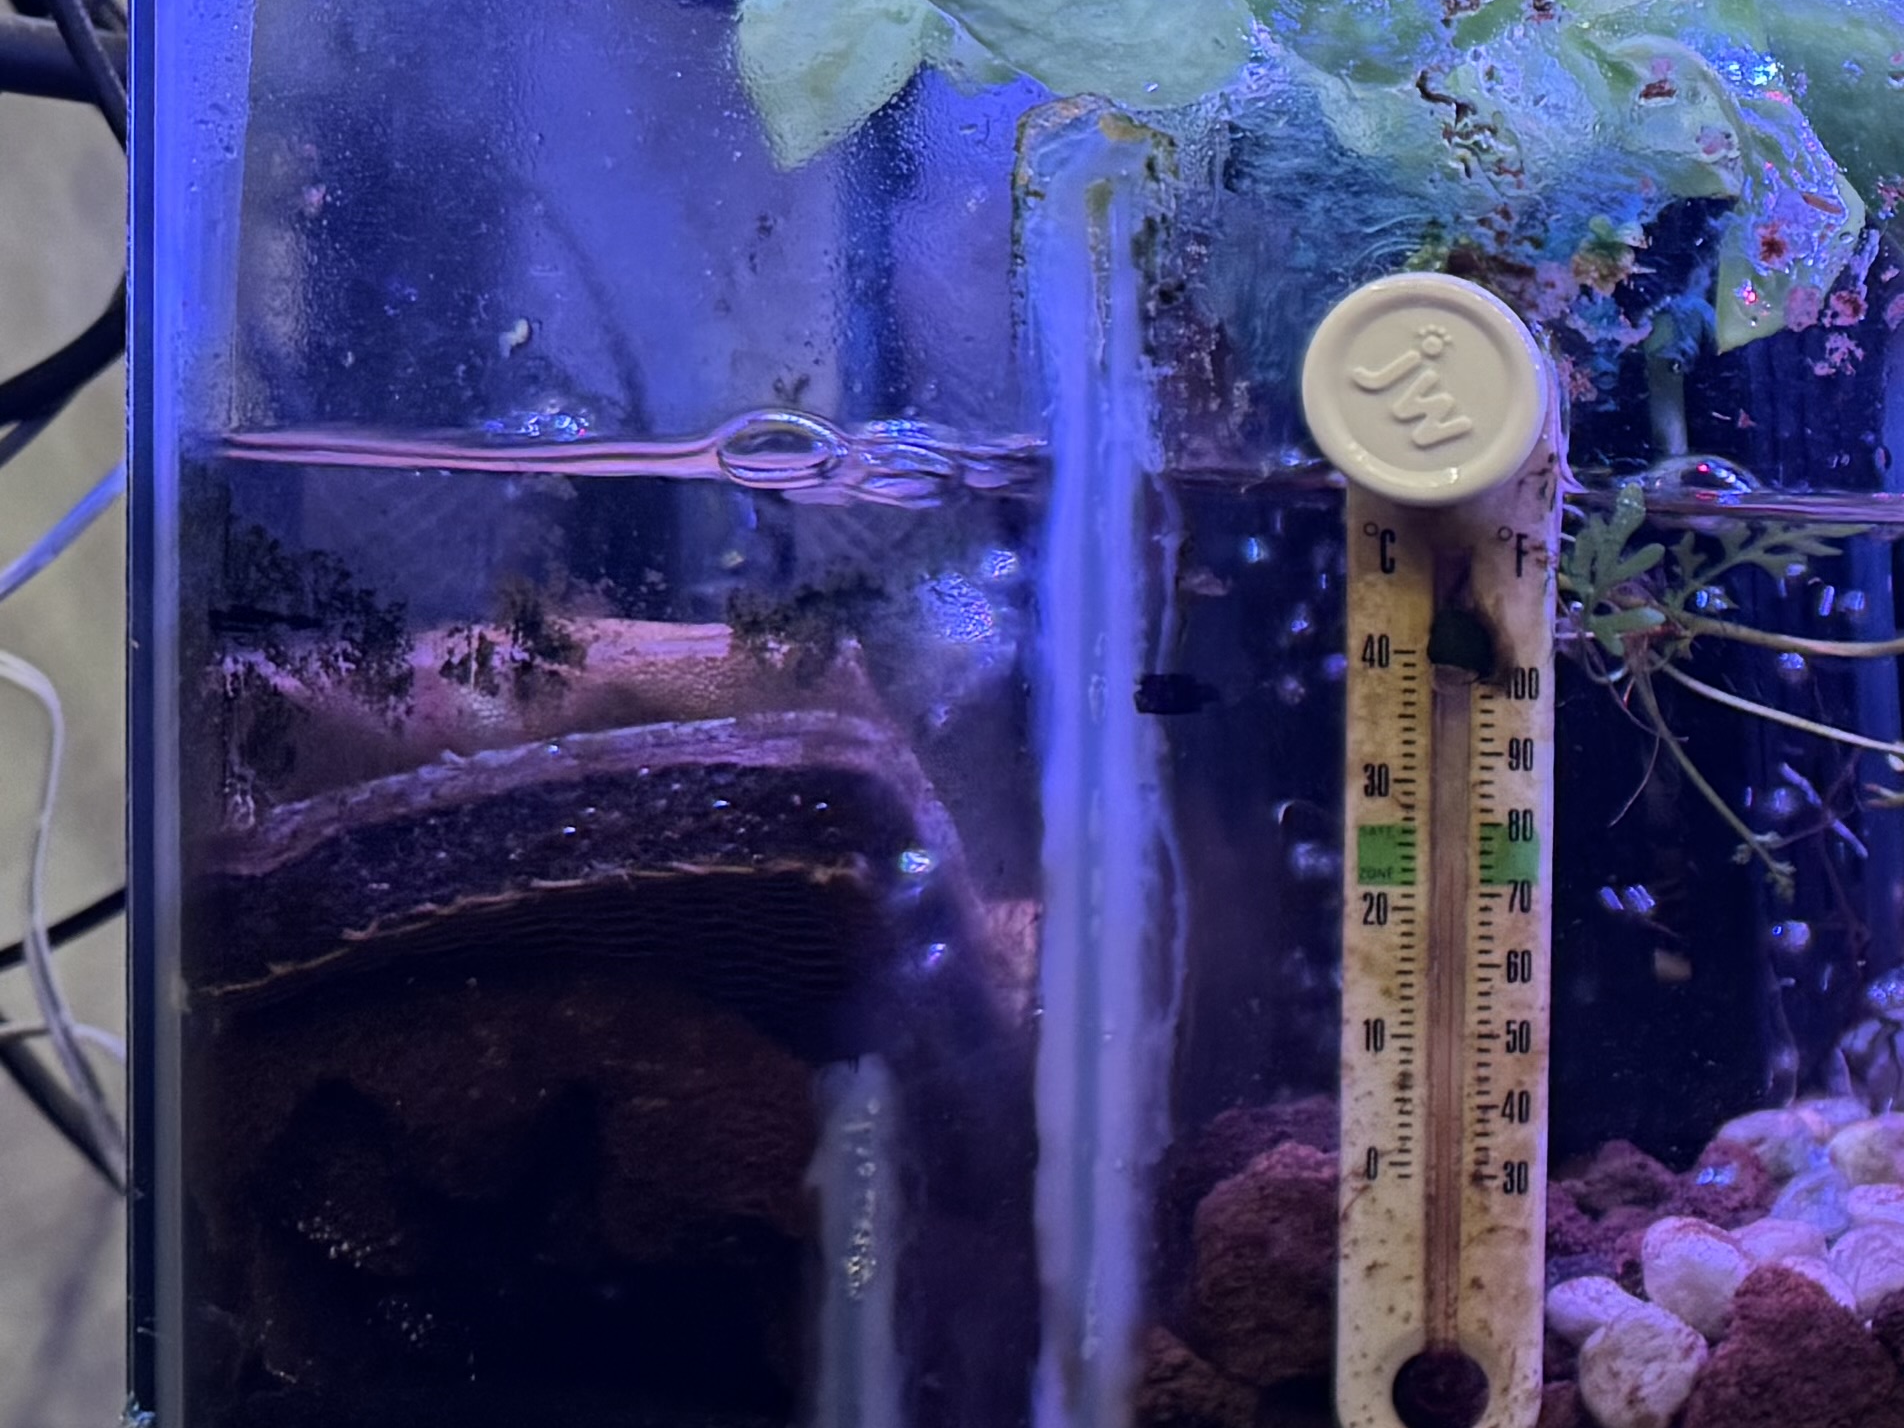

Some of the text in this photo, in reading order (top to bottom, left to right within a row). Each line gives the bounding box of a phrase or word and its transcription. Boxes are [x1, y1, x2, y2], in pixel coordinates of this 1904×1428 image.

[1361, 633, 1390, 669] 40
[1507, 737, 1534, 772] 90
[1362, 763, 1390, 798] 30
[1507, 808, 1534, 843] 80
[1362, 891, 1388, 926] 20
[1507, 879, 1532, 914] 70
[1506, 949, 1532, 984] 60
[1363, 1017, 1386, 1053] 10
[1505, 1019, 1531, 1054] 50
[1501, 1089, 1531, 1124] 40
[1366, 1146, 1379, 1181] 0
[1502, 1160, 1529, 1195] 30
